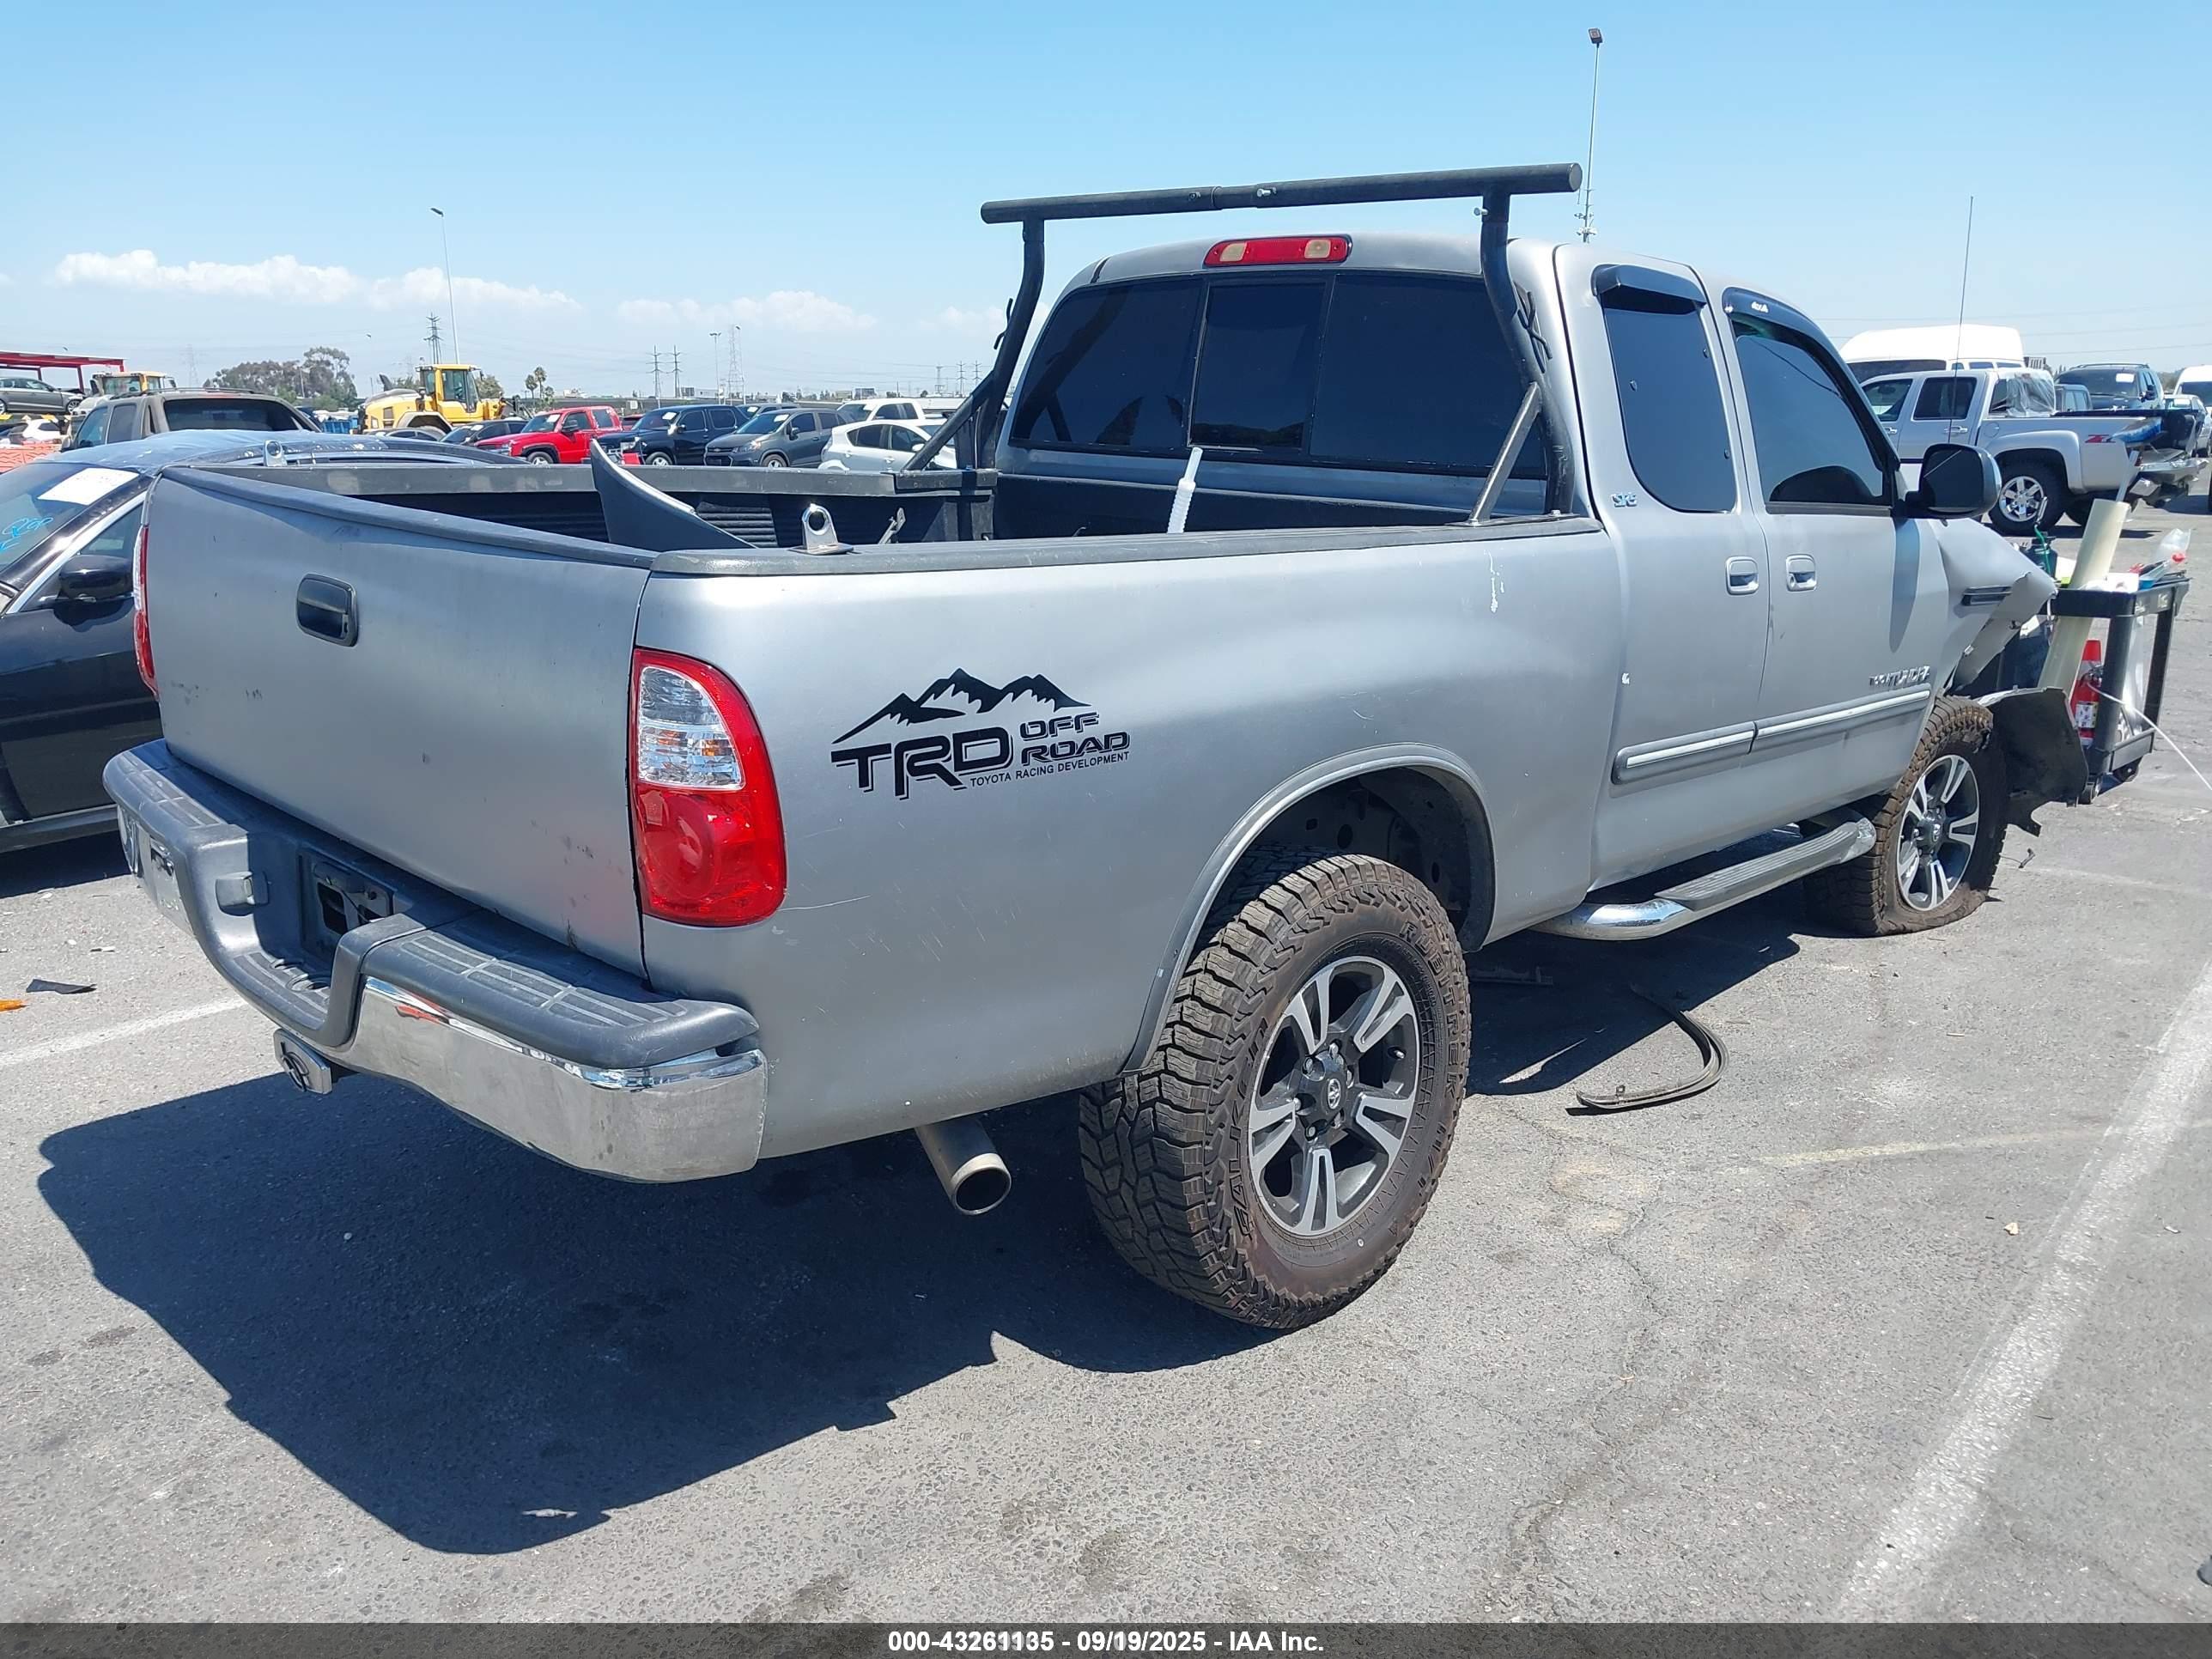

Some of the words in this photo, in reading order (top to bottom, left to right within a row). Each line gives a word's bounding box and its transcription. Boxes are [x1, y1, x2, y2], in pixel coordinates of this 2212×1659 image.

[1019, 712, 1099, 741] OFF
[830, 727, 1013, 800] TRD
[1021, 732, 1130, 766] ROAD
[970, 772, 1012, 787] TOYOTA
[1015, 764, 1054, 780] RACING
[1058, 751, 1130, 772] DEVELOPMENT
